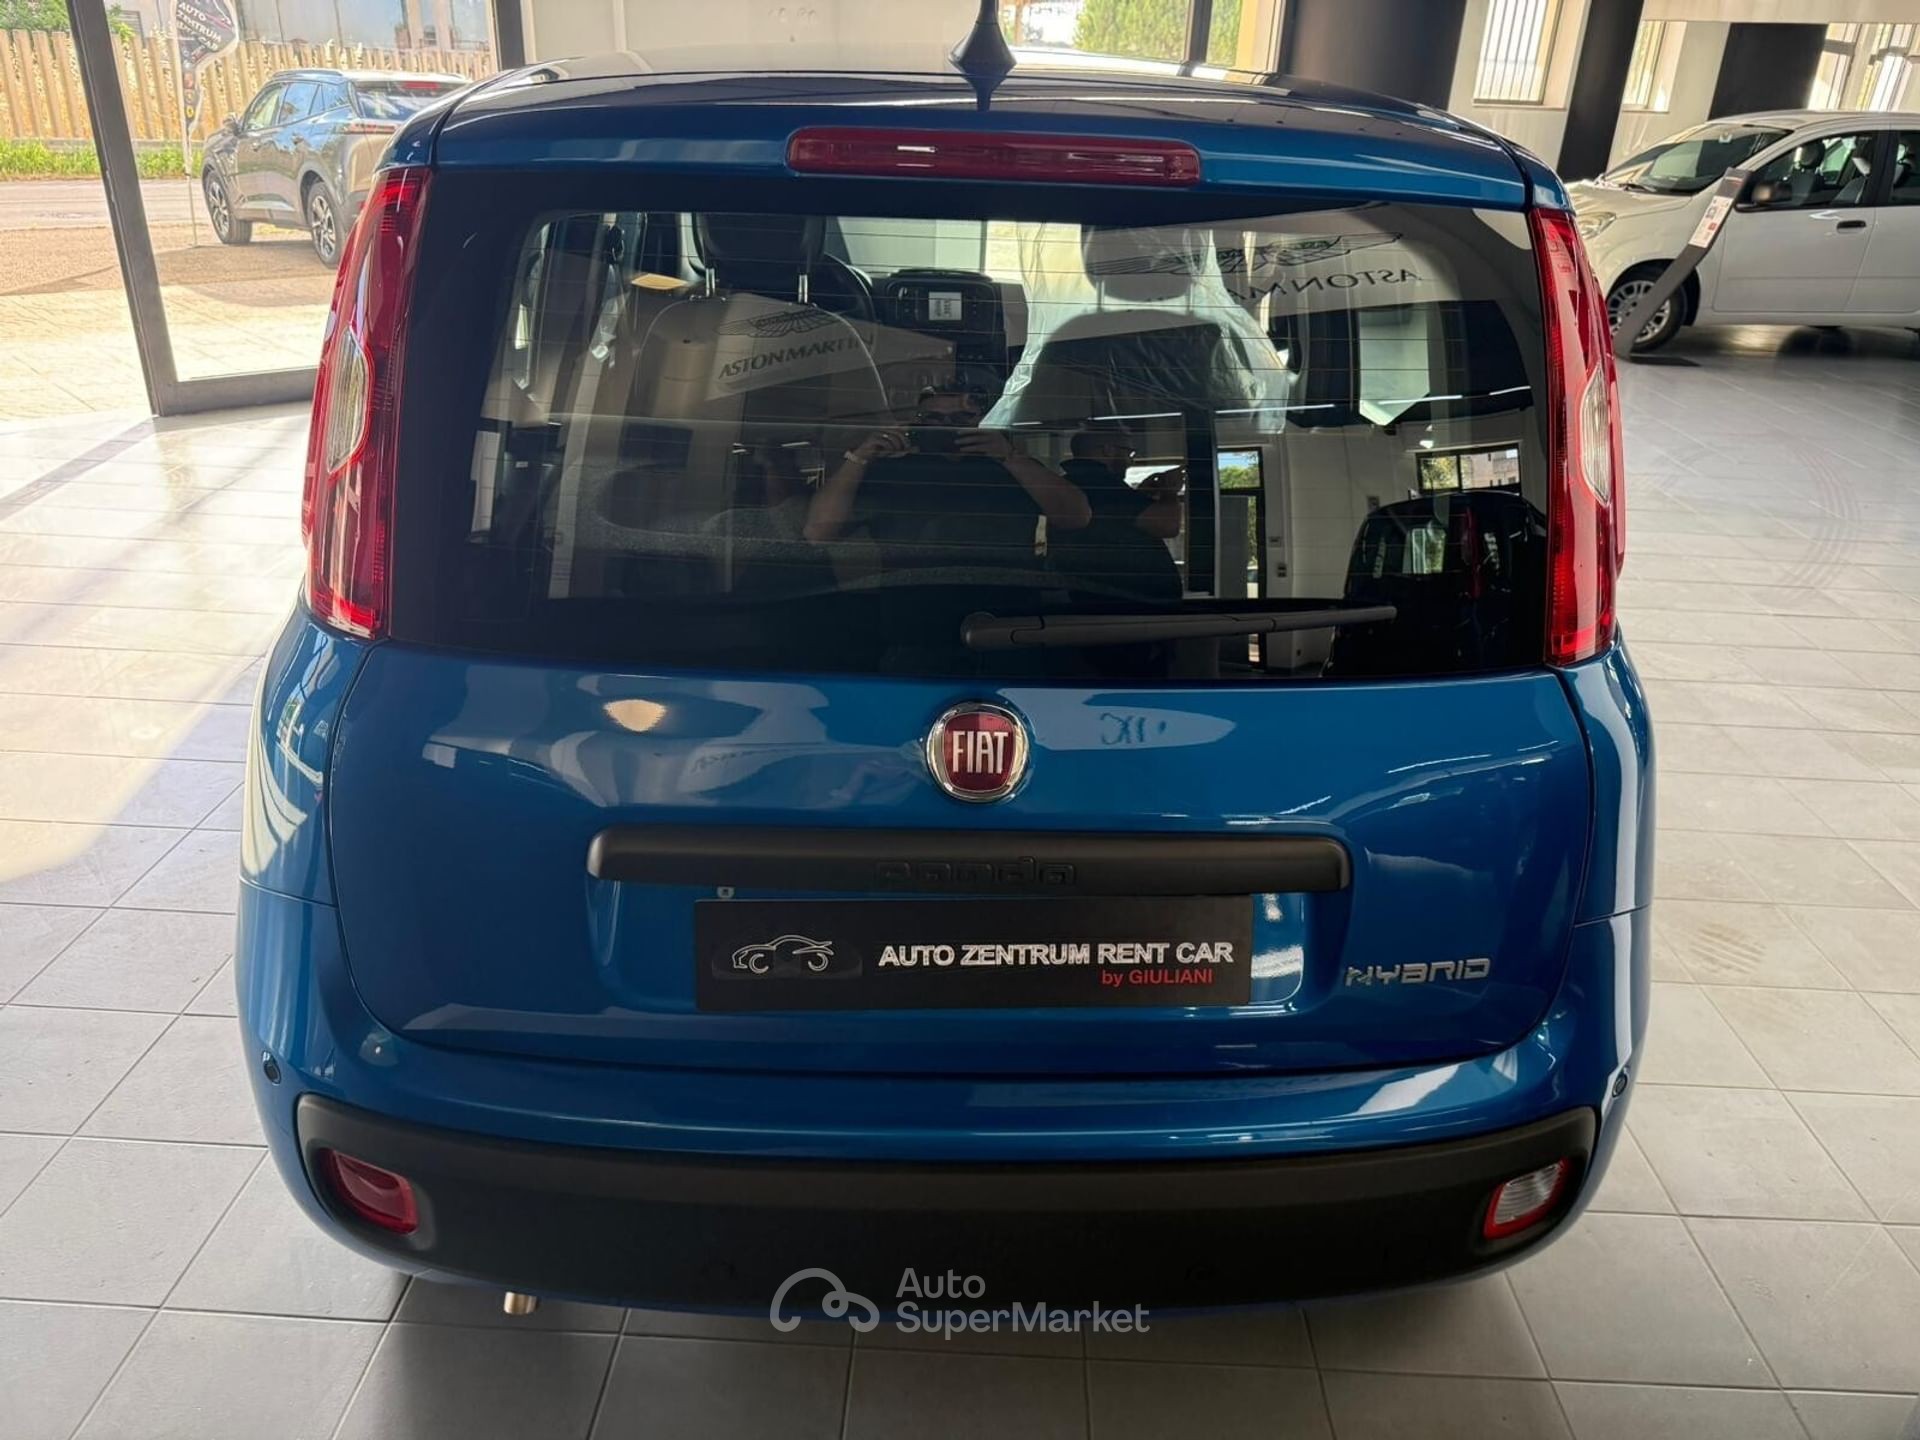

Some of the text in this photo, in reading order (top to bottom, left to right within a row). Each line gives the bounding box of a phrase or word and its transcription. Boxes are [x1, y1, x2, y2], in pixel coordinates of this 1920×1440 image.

[178, 2, 207, 21] AUTO
[952, 730, 1008, 774] FIAT
[878, 941, 1234, 966] AUTO ZENTRUM RENT CAR
[1101, 968, 1213, 988] by GIULIANI
[1345, 957, 1491, 987] HYBRID
